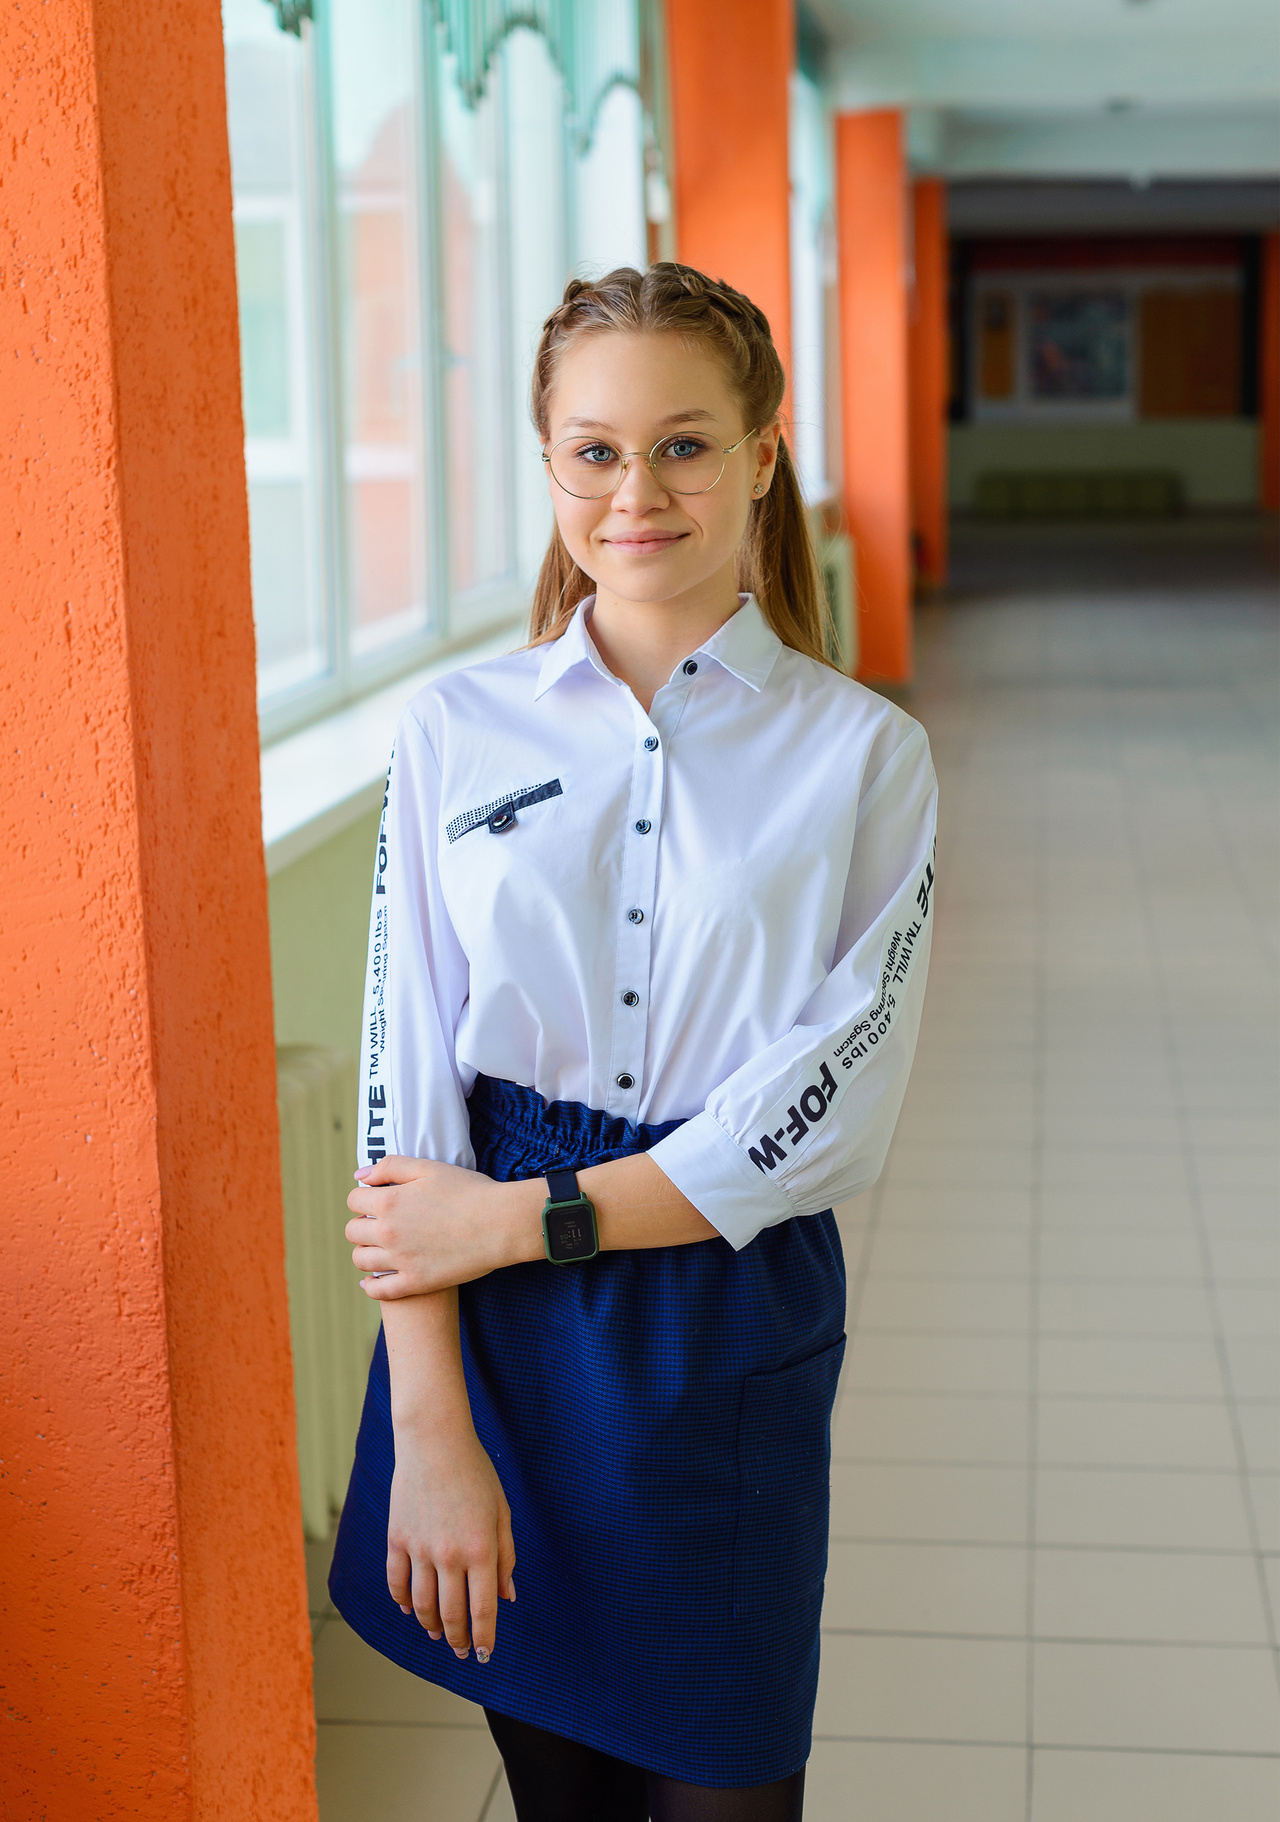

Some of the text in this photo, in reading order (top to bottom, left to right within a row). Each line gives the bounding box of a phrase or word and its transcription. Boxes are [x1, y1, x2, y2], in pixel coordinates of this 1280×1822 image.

[375, 909, 383, 938] lbs
[905, 921, 921, 946] TM
[373, 943, 382, 995] 5,400
[885, 931, 902, 971] Weight
[893, 947, 912, 983] WILL
[869, 972, 890, 1021] Securing
[370, 1006, 378, 1050] WILL
[868, 994, 896, 1045] 5,400
[369, 1053, 379, 1079] TM
[842, 1042, 868, 1070] lbs
[366, 1084, 387, 1167] HITE
